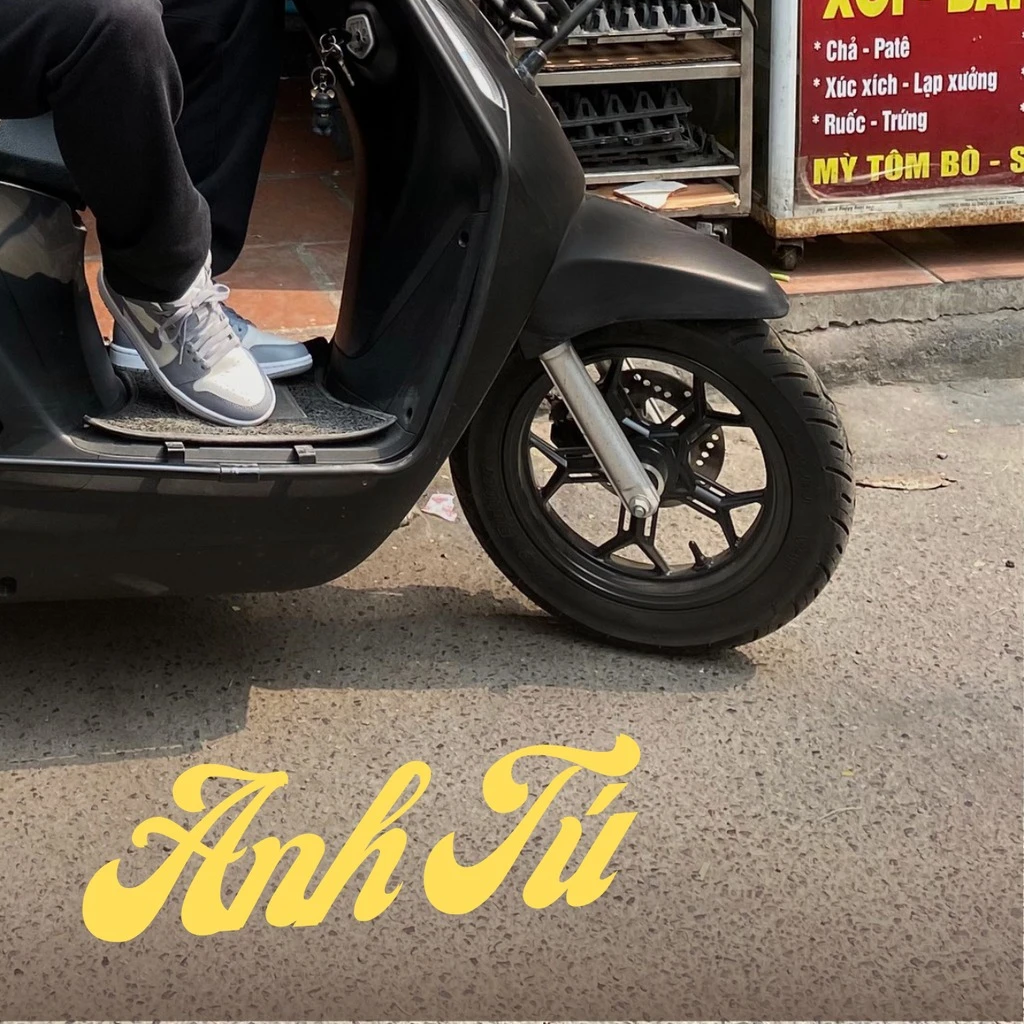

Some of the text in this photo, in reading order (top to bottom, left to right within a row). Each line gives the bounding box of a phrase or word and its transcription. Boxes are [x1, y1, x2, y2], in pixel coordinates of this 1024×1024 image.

[826, 36, 858, 62] Chả
[874, 35, 910, 60] Patê
[825, 75, 857, 99] Xúc
[861, 72, 898, 97] xích
[913, 70, 943, 98] Lạp
[947, 66, 998, 93] xưởng
[824, 108, 866, 136] Ruốc
[882, 108, 928, 133] Trứng
[813, 152, 858, 185] MỲ
[866, 148, 930, 182] TÔM
[940, 144, 980, 178] BÒ
